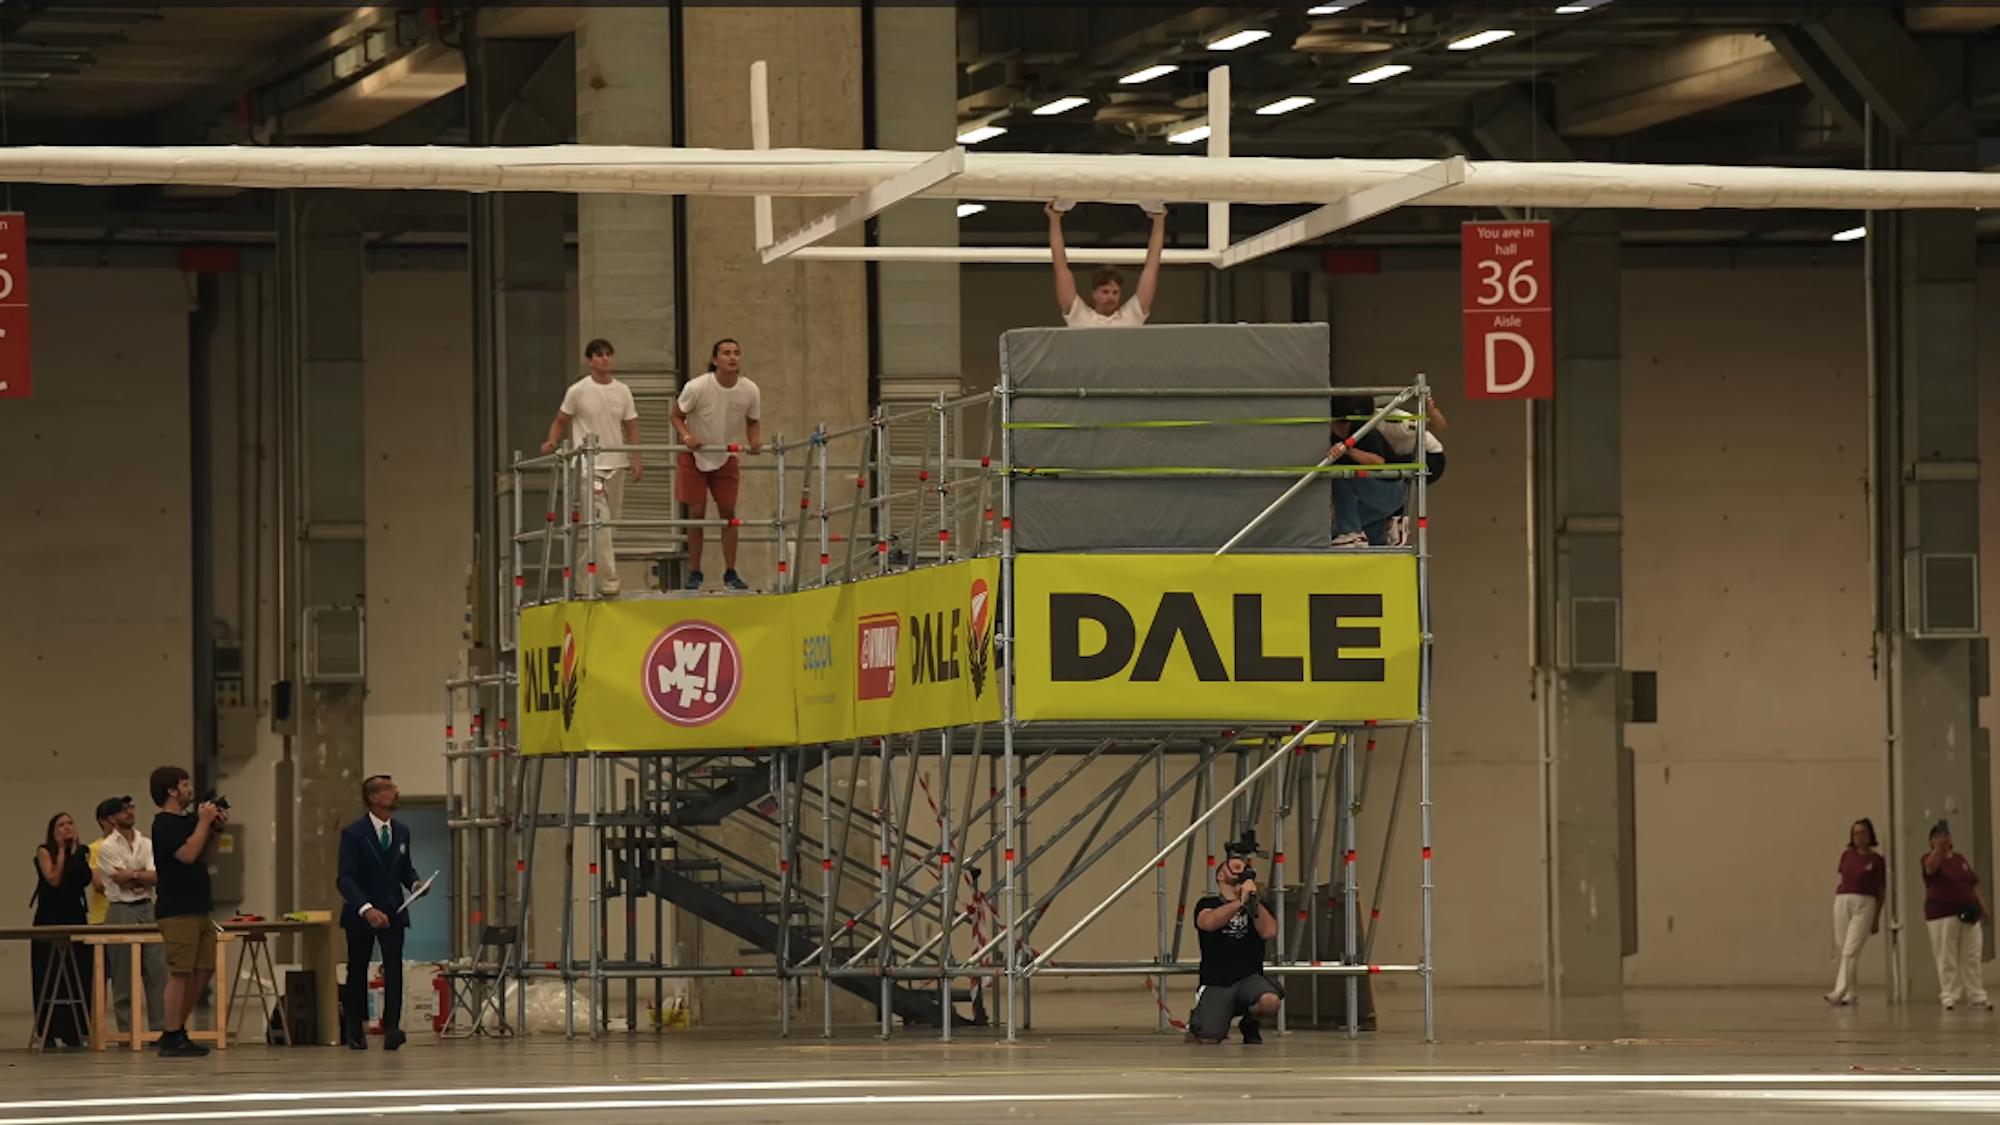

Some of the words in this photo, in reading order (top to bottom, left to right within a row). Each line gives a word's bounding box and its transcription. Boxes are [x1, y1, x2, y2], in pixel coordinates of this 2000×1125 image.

[1477, 227, 1499, 239] You
[1501, 229, 1521, 239] are
[1523, 226, 1535, 238] in
[1495, 243, 1517, 255] hall
[1477, 259, 1538, 305] 36
[1493, 315, 1521, 327] Aisle
[1485, 331, 1535, 393] D
[1049, 592, 1385, 682] DALE
